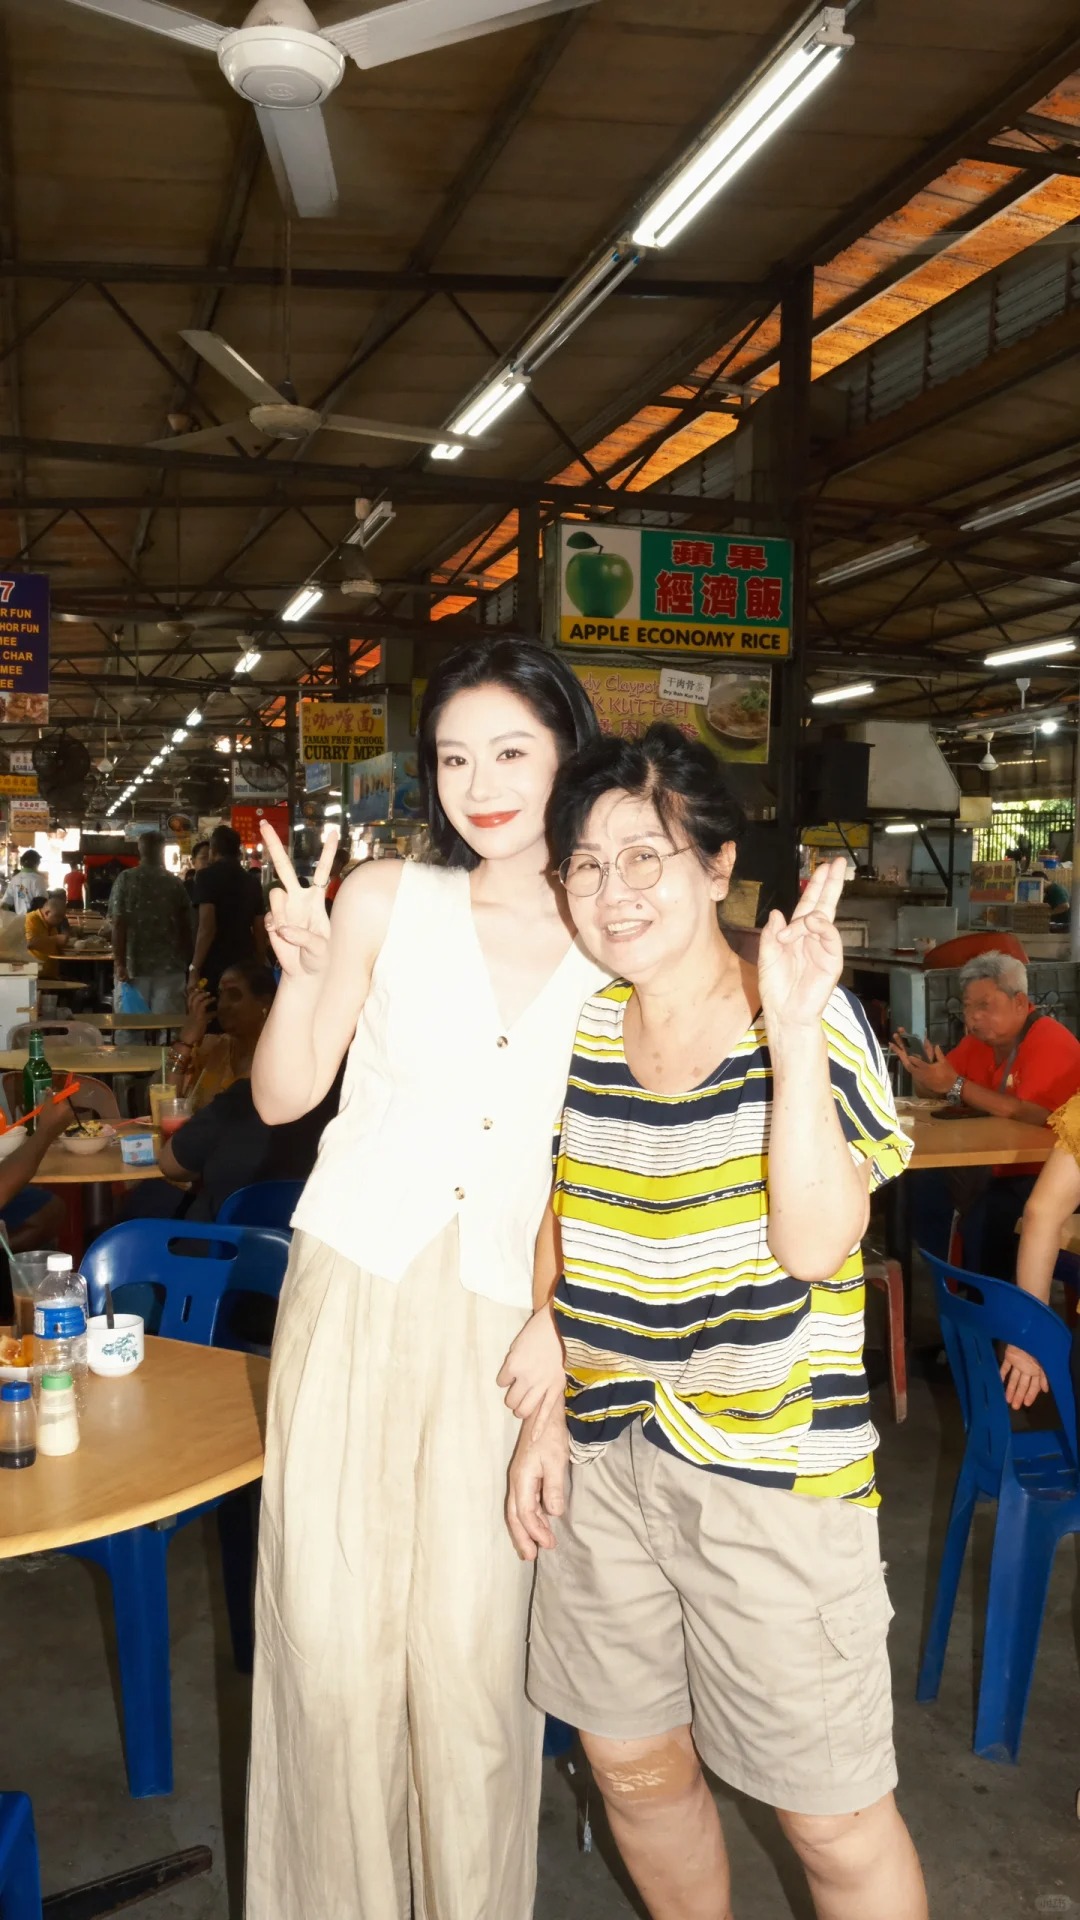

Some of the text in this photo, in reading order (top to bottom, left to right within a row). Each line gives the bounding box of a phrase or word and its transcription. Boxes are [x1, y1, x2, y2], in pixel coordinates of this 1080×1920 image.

[671, 540, 768, 571] 蘋果
[654, 569, 783, 620] 經濟飯
[10, 609, 32, 619] FUN
[21, 623, 40, 634] FUN
[570, 624, 781, 650] APPLE ECONOMY RICE
[3, 651, 33, 661] CHAR
[0, 665, 23, 675] MEE
[581, 672, 660, 698] dy Claypot
[592, 696, 605, 713] K
[609, 697, 646, 716] KUT
[303, 735, 384, 745] TAMAN FREE SCHOOL
[304, 745, 350, 760] CURRY
